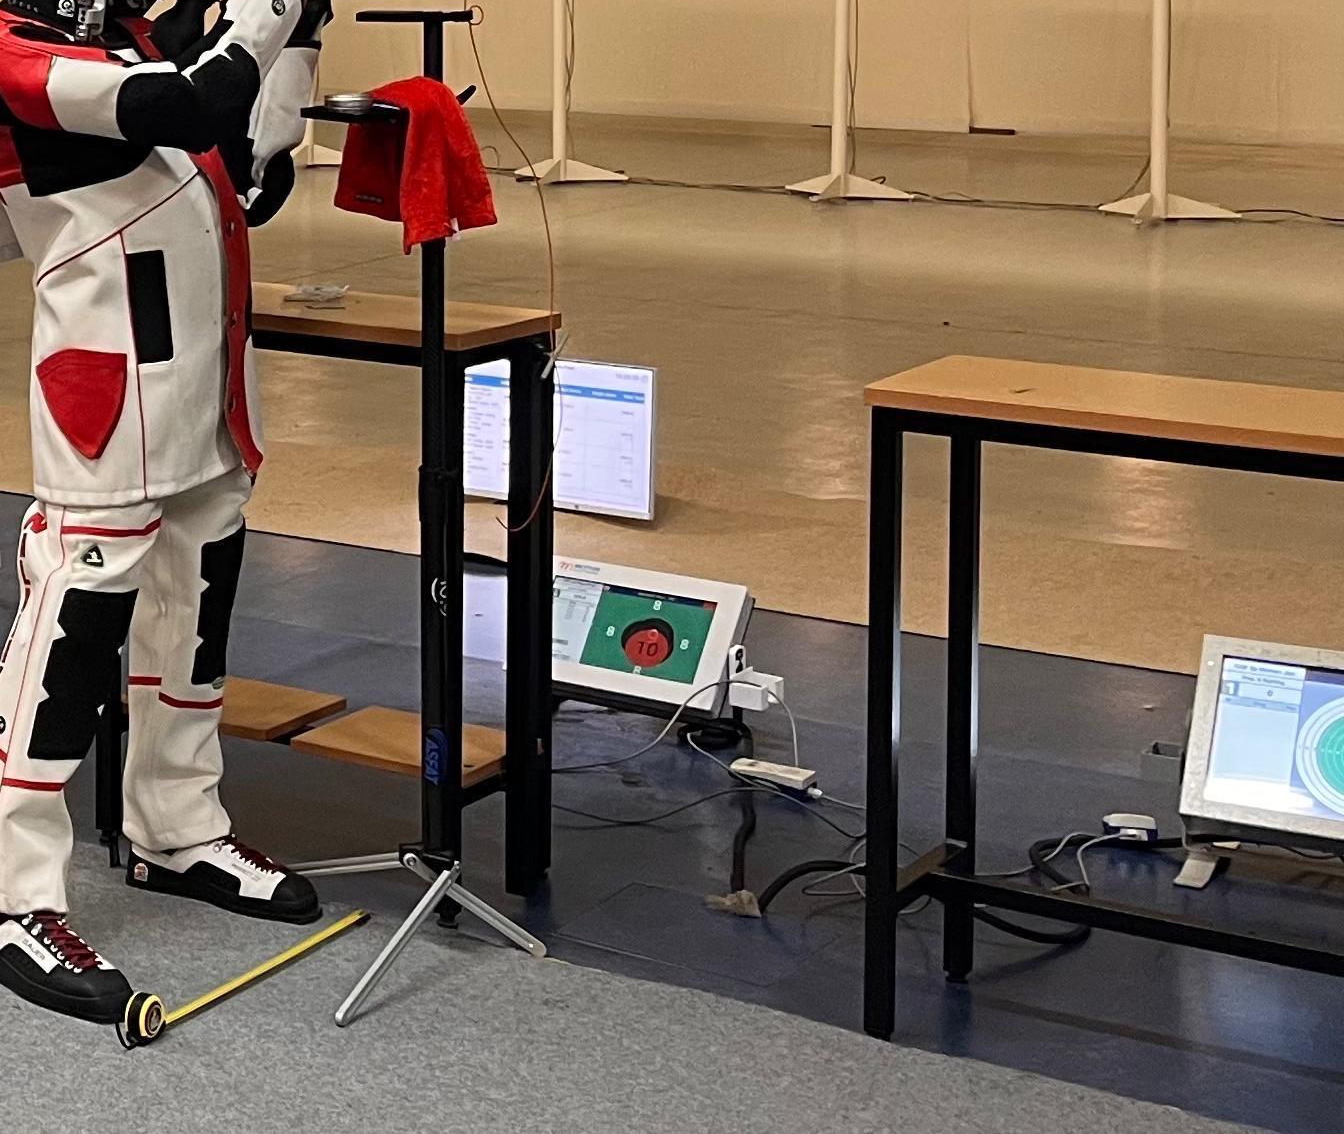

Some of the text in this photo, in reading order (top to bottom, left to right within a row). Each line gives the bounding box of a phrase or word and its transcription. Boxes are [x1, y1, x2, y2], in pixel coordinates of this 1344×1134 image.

[653, 599, 662, 610] 8
[606, 625, 616, 637] 8
[636, 641, 659, 657] 10
[679, 639, 690, 650] 8
